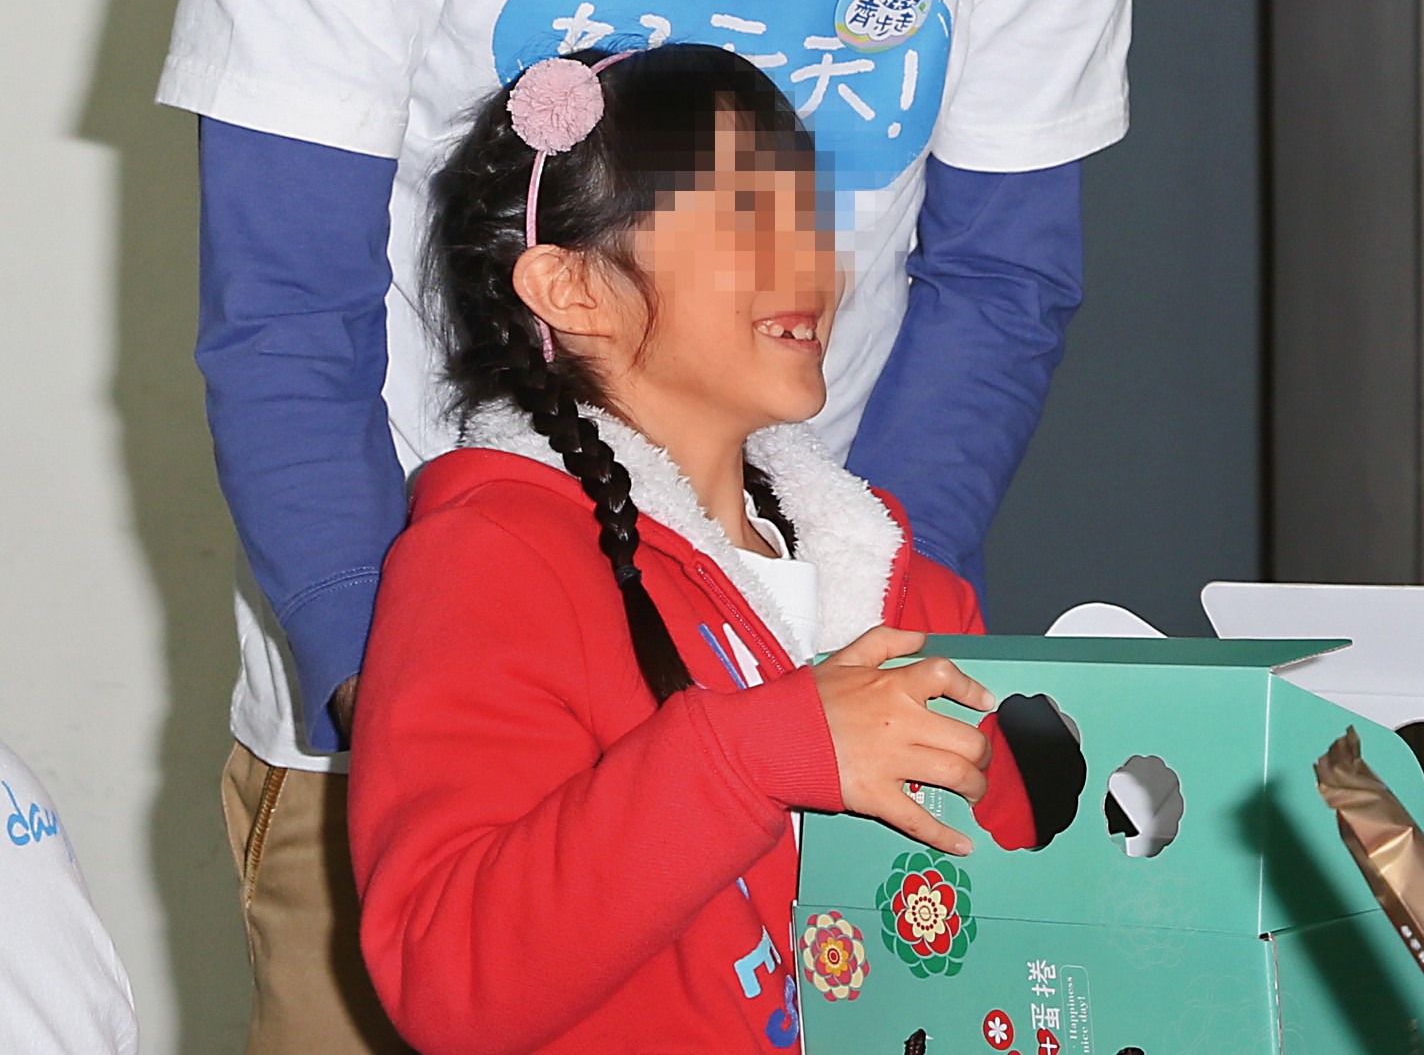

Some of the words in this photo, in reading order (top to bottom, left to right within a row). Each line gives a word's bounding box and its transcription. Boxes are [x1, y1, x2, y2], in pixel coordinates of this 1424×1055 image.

[1067, 976, 1079, 1040] Happiness
[1077, 996, 1088, 1023] day!
[1080, 1026, 1090, 1054] nice
